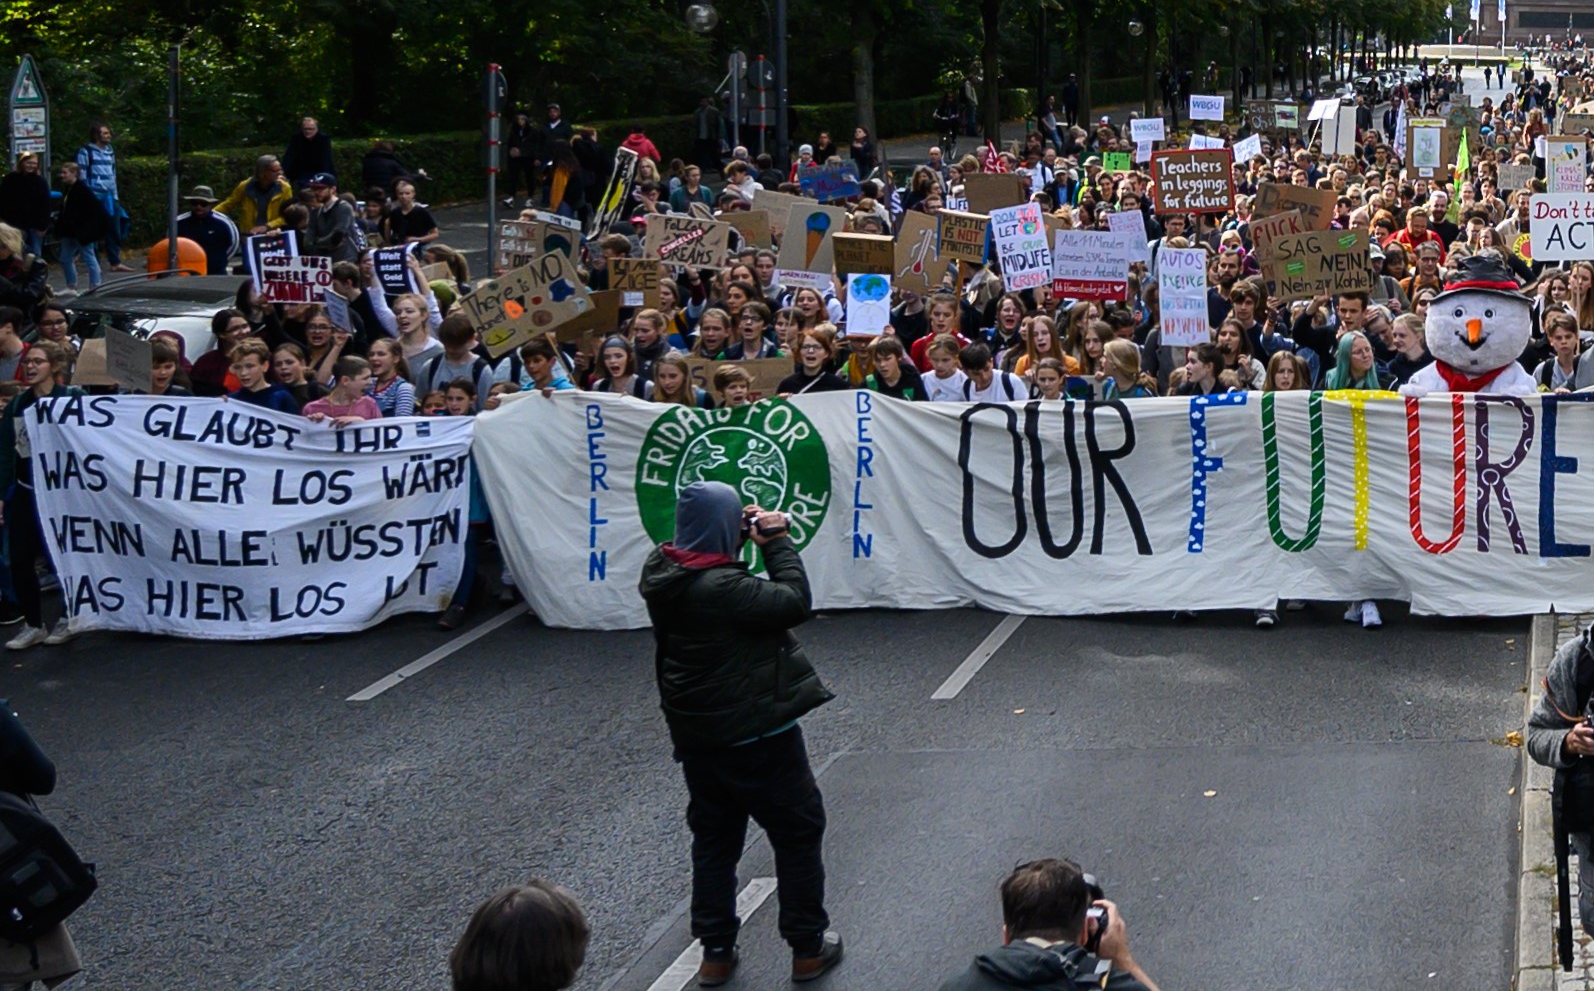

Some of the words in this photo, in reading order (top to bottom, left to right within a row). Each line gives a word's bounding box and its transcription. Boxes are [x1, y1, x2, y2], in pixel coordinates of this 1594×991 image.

[1156, 155, 1222, 176] Teachers
[1161, 176, 1173, 191] in
[1177, 172, 1228, 195] leggings
[1163, 195, 1180, 209] for
[1184, 193, 1228, 208] future
[1534, 200, 1580, 220] Don't
[943, 215, 986, 231] PLASTIC
[999, 224, 1018, 238] LET
[944, 227, 954, 239] IS
[958, 231, 980, 243] NOT
[1061, 233, 1078, 246] Alle
[1002, 242, 1014, 254] BE
[1278, 237, 1322, 260] SAG
[1002, 248, 1050, 275] MIDLIFE
[1160, 251, 1203, 270] AUTOS
[460, 286, 514, 327] There
[530, 253, 563, 287] NO
[1281, 276, 1313, 296] Nein
[35, 397, 118, 428] WAS
[143, 404, 300, 451] GLAUBT
[744, 400, 810, 451] FOR
[40, 453, 108, 492] WAS
[133, 459, 247, 505] HIER
[272, 469, 356, 506] LOS
[853, 391, 874, 560] BERLIN
[960, 401, 1153, 559] OUR
[586, 404, 610, 582] BERLIN
[50, 515, 146, 557] WENN
[146, 578, 248, 622] HIER
[270, 582, 348, 622] LOS
